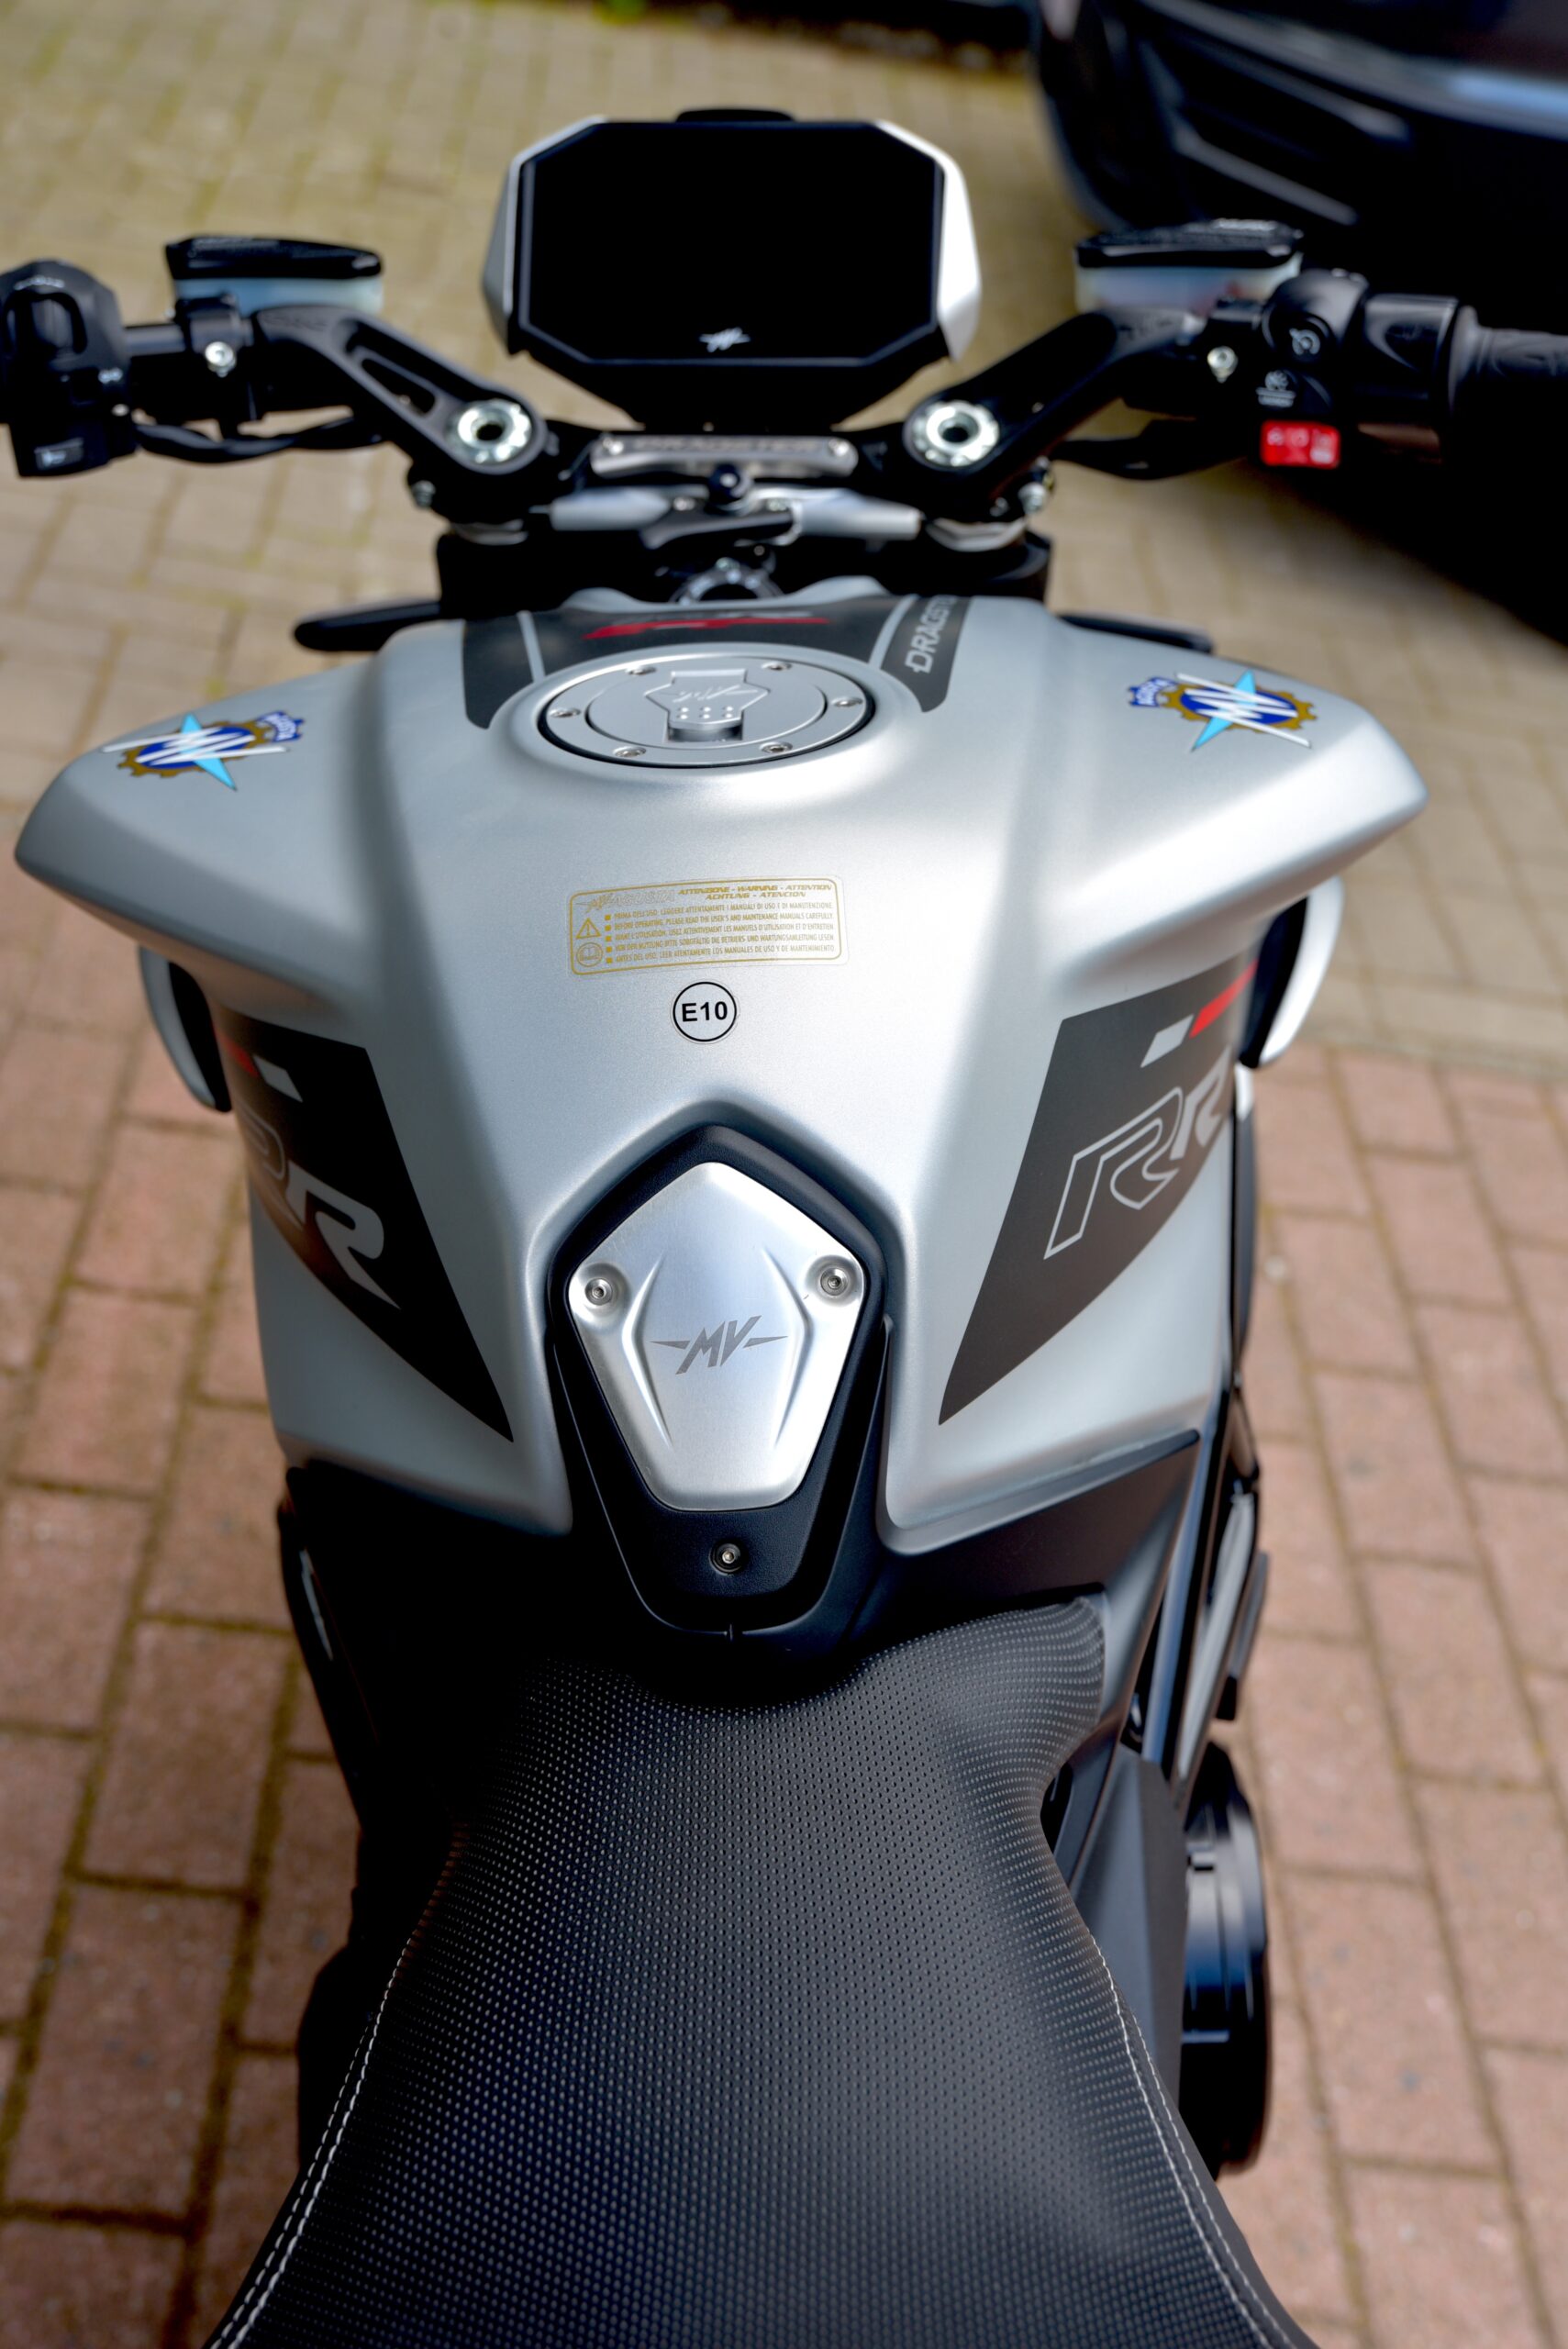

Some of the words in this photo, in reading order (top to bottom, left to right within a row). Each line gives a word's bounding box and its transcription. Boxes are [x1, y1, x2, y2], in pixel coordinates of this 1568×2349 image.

[684, 926, 722, 934] ATTENTIVEMENT
[761, 933, 817, 941] WARTUNGSANLEITUNG
[674, 948, 710, 956] ATENTAMENTE
[682, 1001, 728, 1022] E10
[665, 1315, 773, 1375] MV
